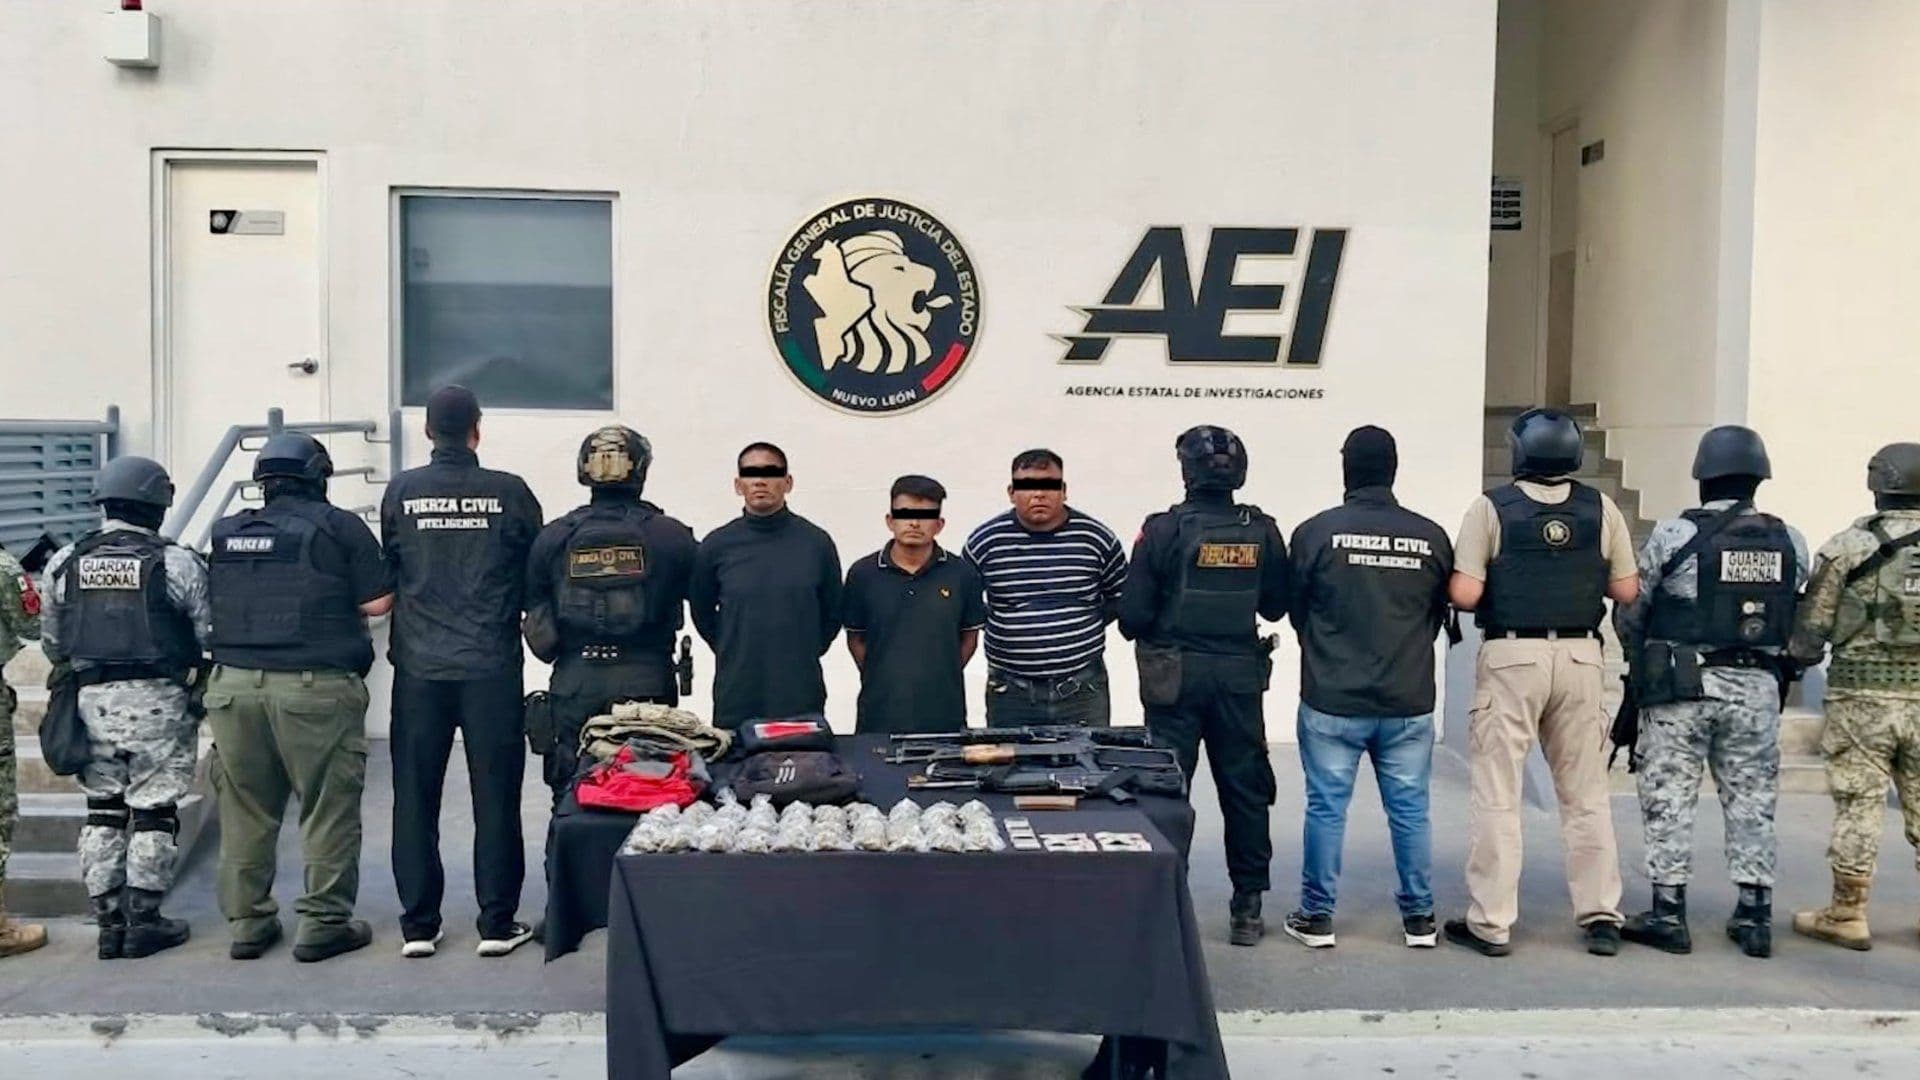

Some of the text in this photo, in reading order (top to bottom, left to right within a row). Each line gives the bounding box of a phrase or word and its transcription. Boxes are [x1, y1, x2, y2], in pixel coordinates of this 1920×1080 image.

[773, 203, 976, 336] FISCALÍA GENERAL DE JUSTICIA DEL ESTADO
[1055, 226, 1348, 365] AEI
[832, 387, 917, 407] NUEVO LEÓN
[1065, 386, 1324, 399] AGENCIA ESTATAL DE INVESTIGACIONES
[403, 498, 503, 515] FUERZA CIVIL
[416, 518, 489, 529] INTELIGENCIA
[226, 538, 257, 551] POLICE
[1332, 533, 1433, 556] FUERZA CIVIL
[82, 559, 136, 573] GUARDIA
[1348, 553, 1422, 570] INTELIGENCIA
[1728, 551, 1777, 567] GUARDIA
[81, 573, 137, 586] NACIONAL
[1727, 567, 1777, 582] NACIONAL
